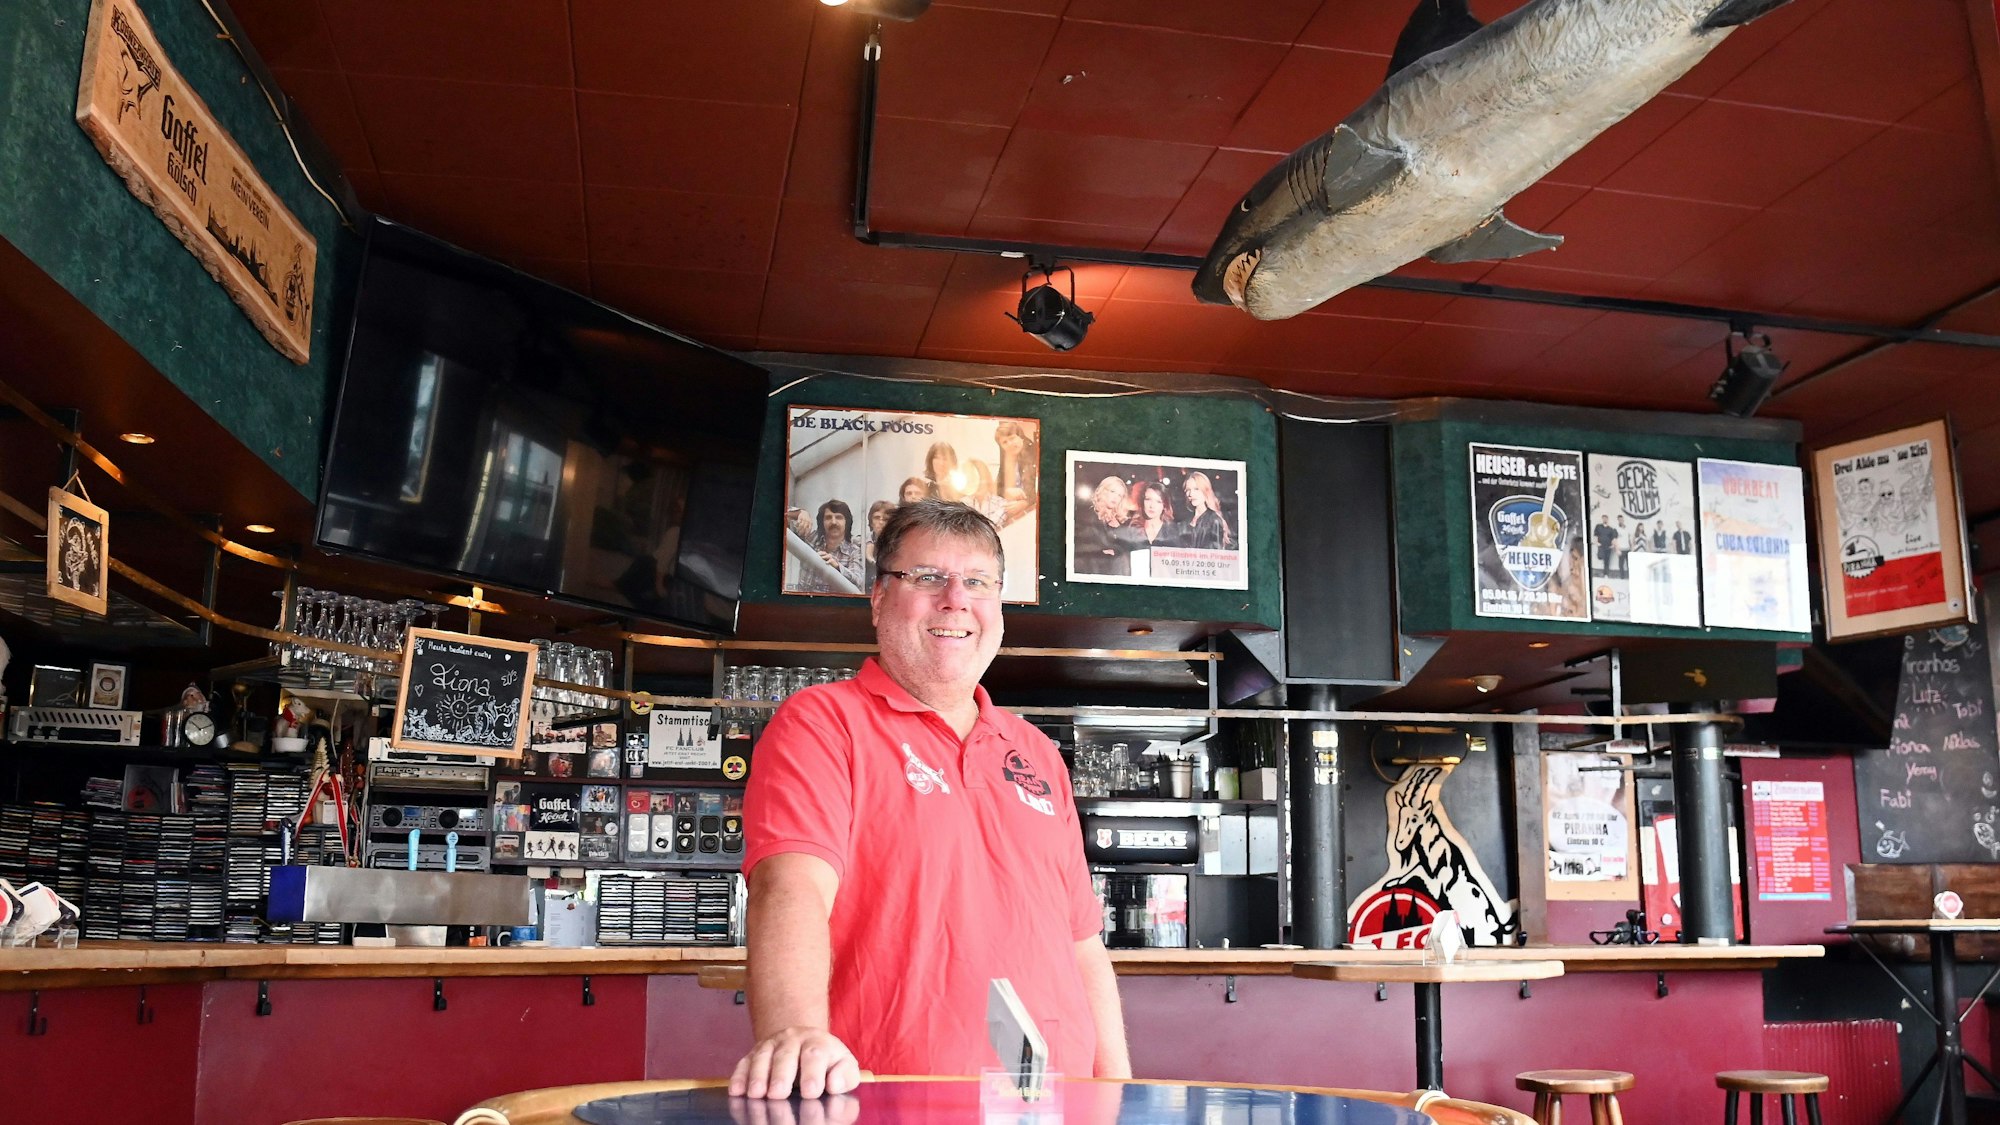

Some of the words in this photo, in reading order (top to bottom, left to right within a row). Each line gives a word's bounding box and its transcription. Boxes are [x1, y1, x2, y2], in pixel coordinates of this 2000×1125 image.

[161, 95, 208, 185] Gaffel
[167, 152, 197, 206] Kölsch
[230, 177, 249, 206] MEIN
[248, 195, 270, 230] VEREIN
[792, 416, 816, 429] DE
[820, 417, 877, 432] BLÄCK
[880, 420, 934, 435] FÖÖSS
[1475, 453, 1527, 477] HEUSER
[1527, 463, 1538, 478] &
[1538, 461, 1577, 480] GÄSTE
[1617, 466, 1657, 489] DECKE
[1618, 489, 1660, 514] TRUMM
[1497, 511, 1525, 525] Gaffel
[1716, 532, 1744, 552] CUBA
[1747, 534, 1790, 555] COLONIA
[1217, 561, 1231, 569] Uhr
[1508, 551, 1552, 566] HEUSER
[1175, 568, 1200, 576] Eintritt
[1211, 569, 1217, 577] €
[1548, 592, 1563, 603] Uhr
[428, 641, 447, 652] Heute
[448, 645, 472, 656] bedient
[1912, 682, 1942, 704] Lutz
[1952, 699, 1983, 719] Tobi
[657, 713, 712, 727] Stammtisc
[1943, 731, 1981, 751] Niklas
[539, 797, 571, 811] Gaffel
[1880, 788, 1912, 808] Fabi
[1564, 822, 1609, 836] PIRANHA
[1566, 837, 1589, 846] Eintritt
[1591, 837, 1599, 846] 10
